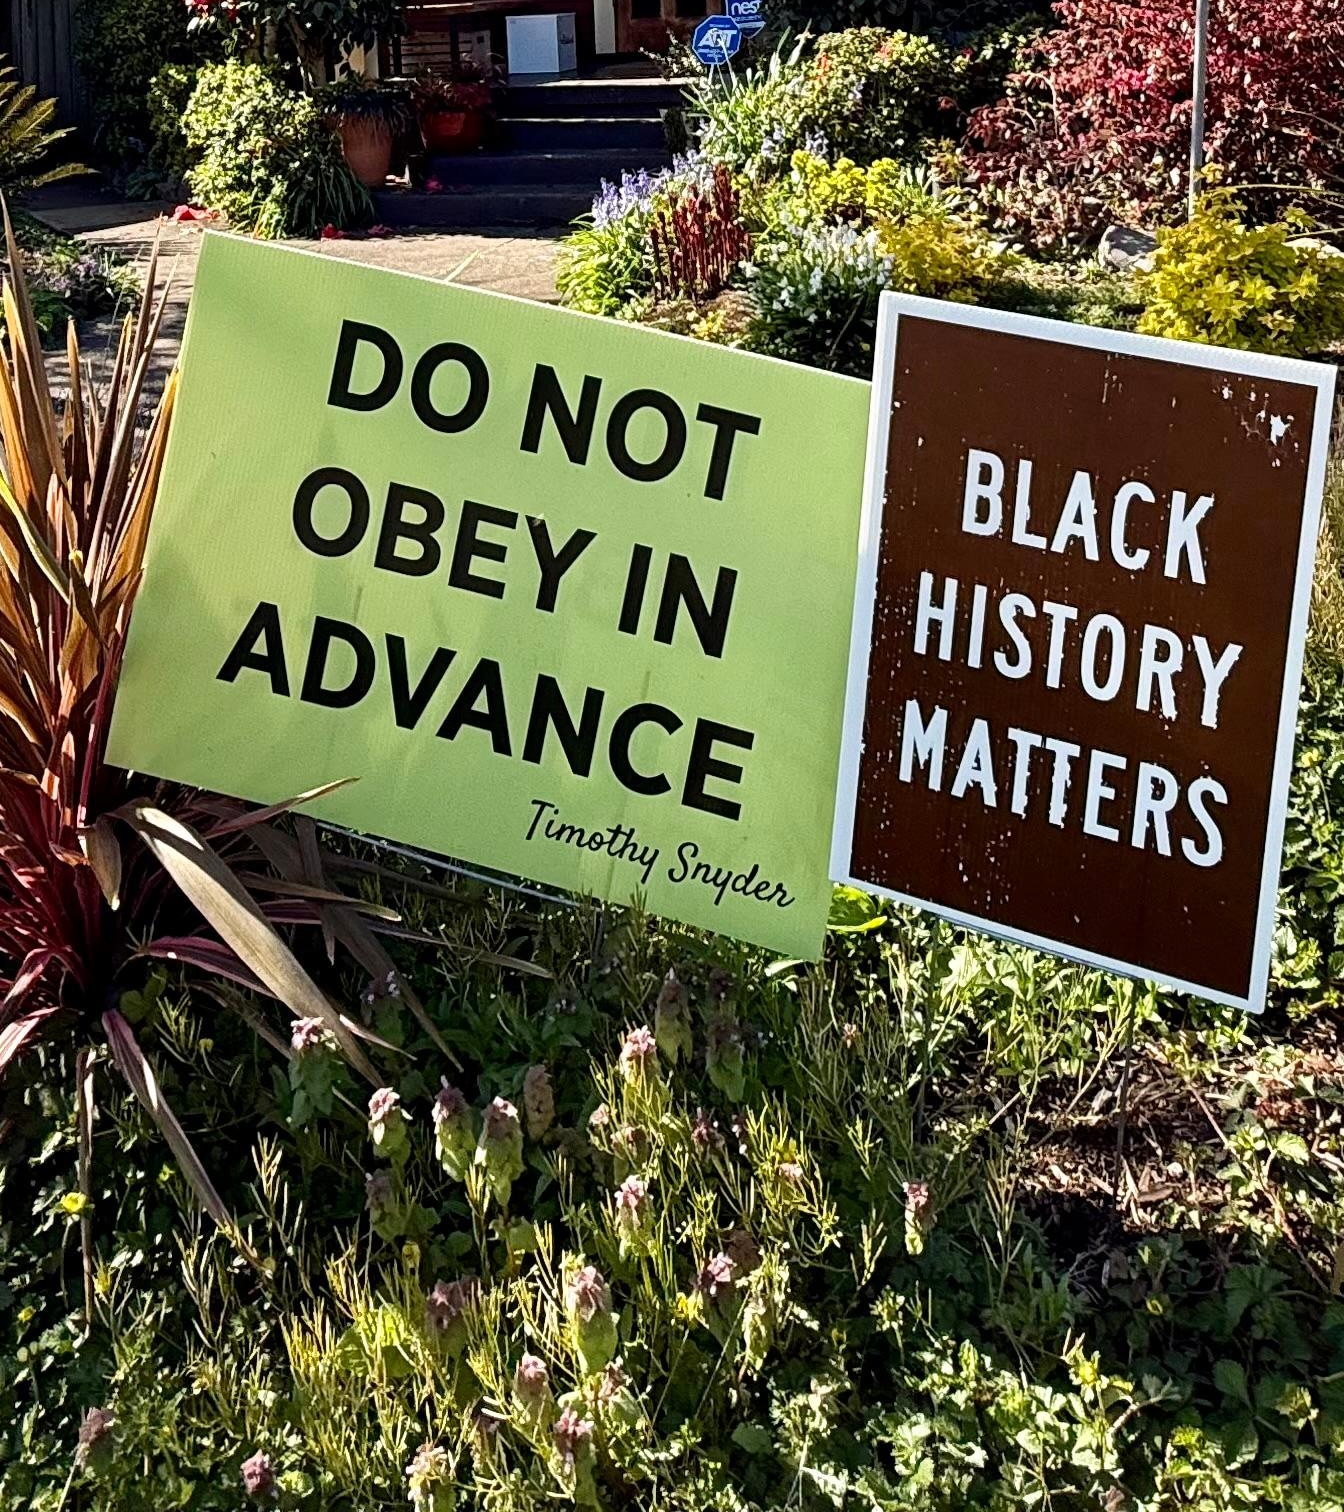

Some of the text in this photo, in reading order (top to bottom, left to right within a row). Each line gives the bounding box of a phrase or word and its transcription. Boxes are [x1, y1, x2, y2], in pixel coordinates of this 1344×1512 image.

[698, 28, 737, 47] ADT
[327, 319, 762, 501] DO NOT
[292, 466, 738, 659] OBEY IN
[960, 448, 1216, 586] BLACK
[214, 601, 755, 822] ADVANCE
[912, 570, 1244, 731] HISTORY
[525, 798, 796, 908] Timothy Snyder
[897, 697, 1229, 868] MATTERS
